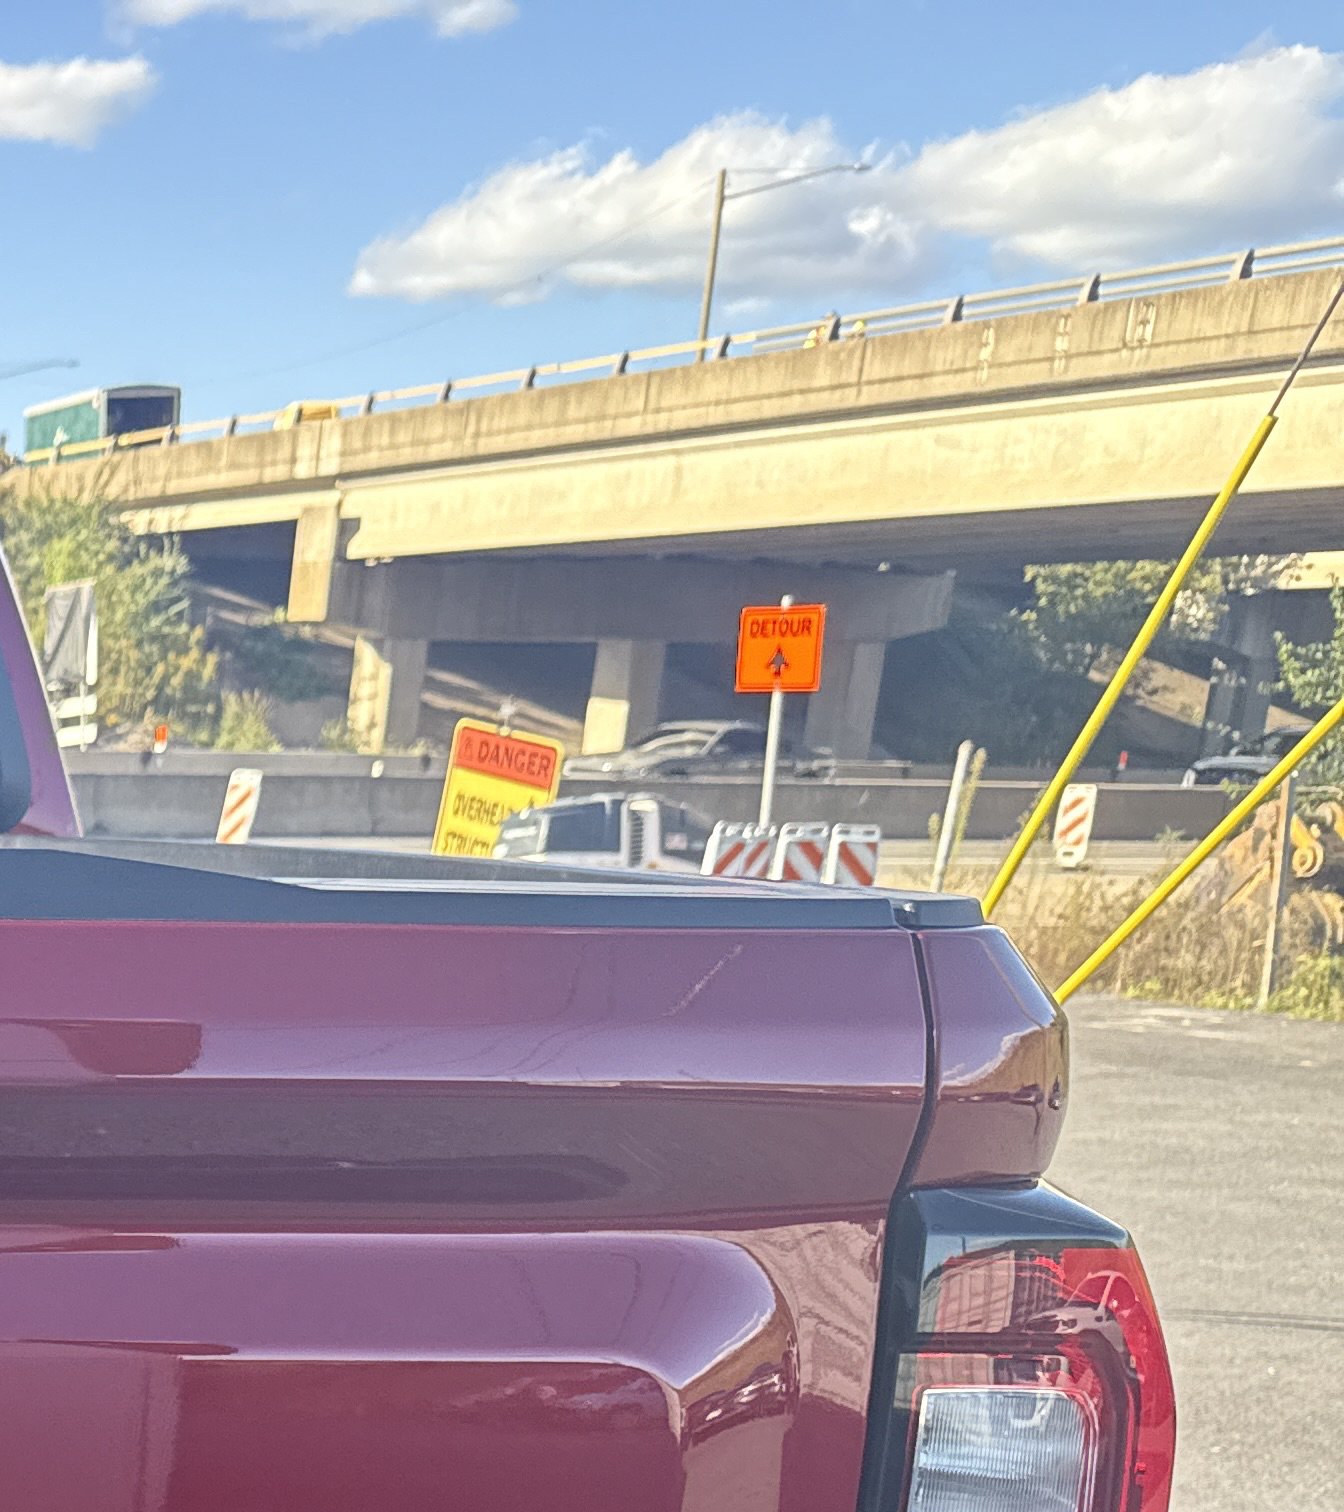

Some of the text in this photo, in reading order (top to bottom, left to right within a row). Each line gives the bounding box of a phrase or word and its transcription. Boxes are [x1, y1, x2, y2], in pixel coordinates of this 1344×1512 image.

[750, 617, 812, 638] DETOUR
[477, 739, 551, 778] DANGER
[452, 792, 506, 825] OVERHEA
